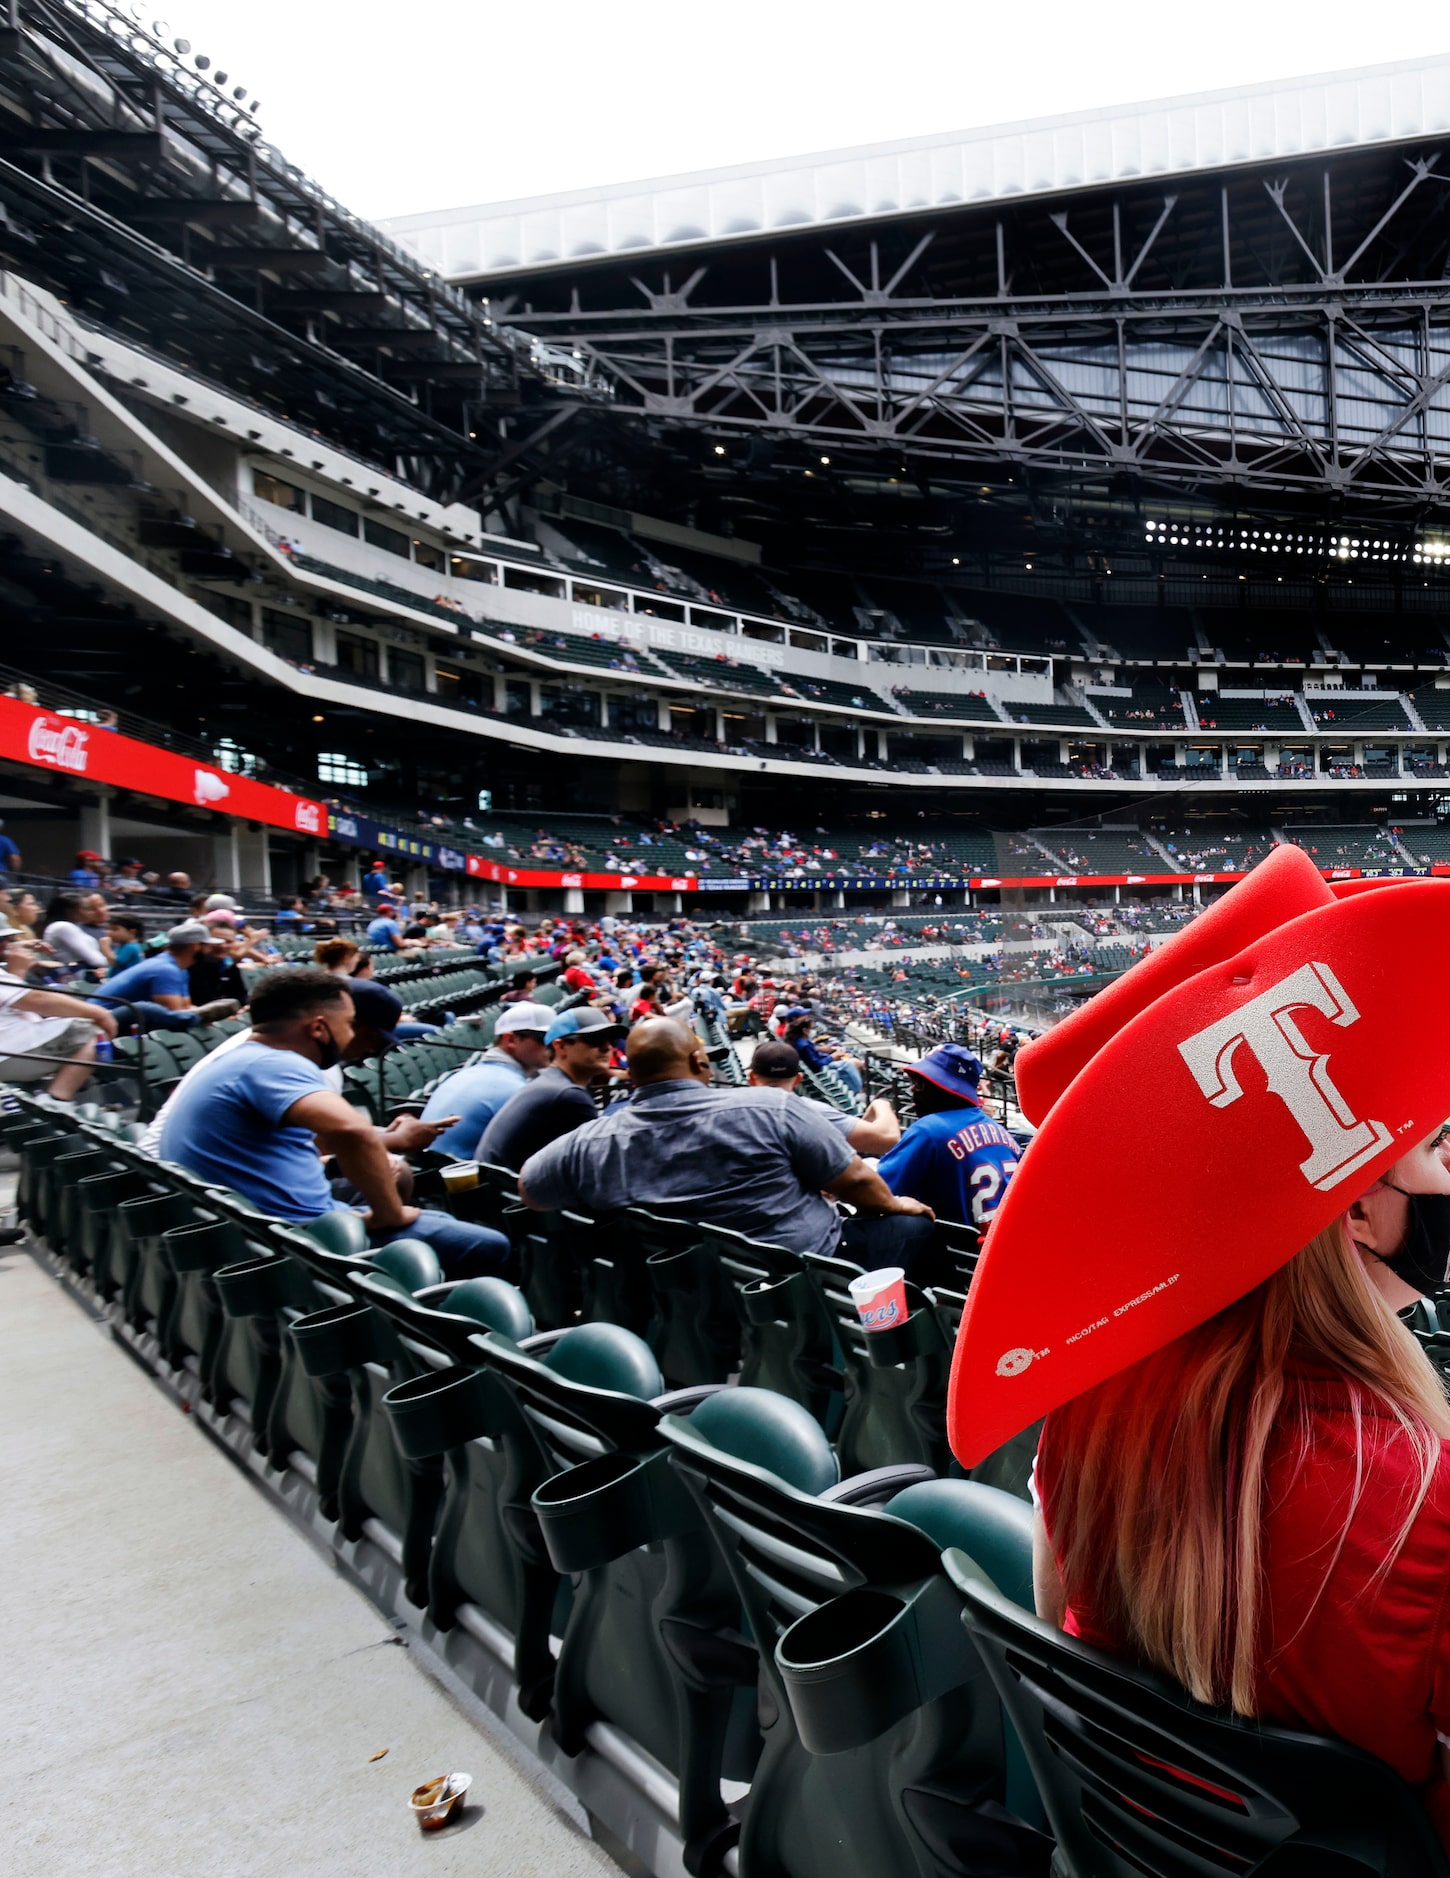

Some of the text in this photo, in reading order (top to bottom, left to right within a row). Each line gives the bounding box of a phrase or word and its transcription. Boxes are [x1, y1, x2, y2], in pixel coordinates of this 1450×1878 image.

[571, 609, 785, 667] HOME OF THE TEXAS RANGERS
[1177, 960, 1394, 1192] T
[1396, 1119, 1415, 1135] TM
[1033, 1347, 1051, 1361] TM
